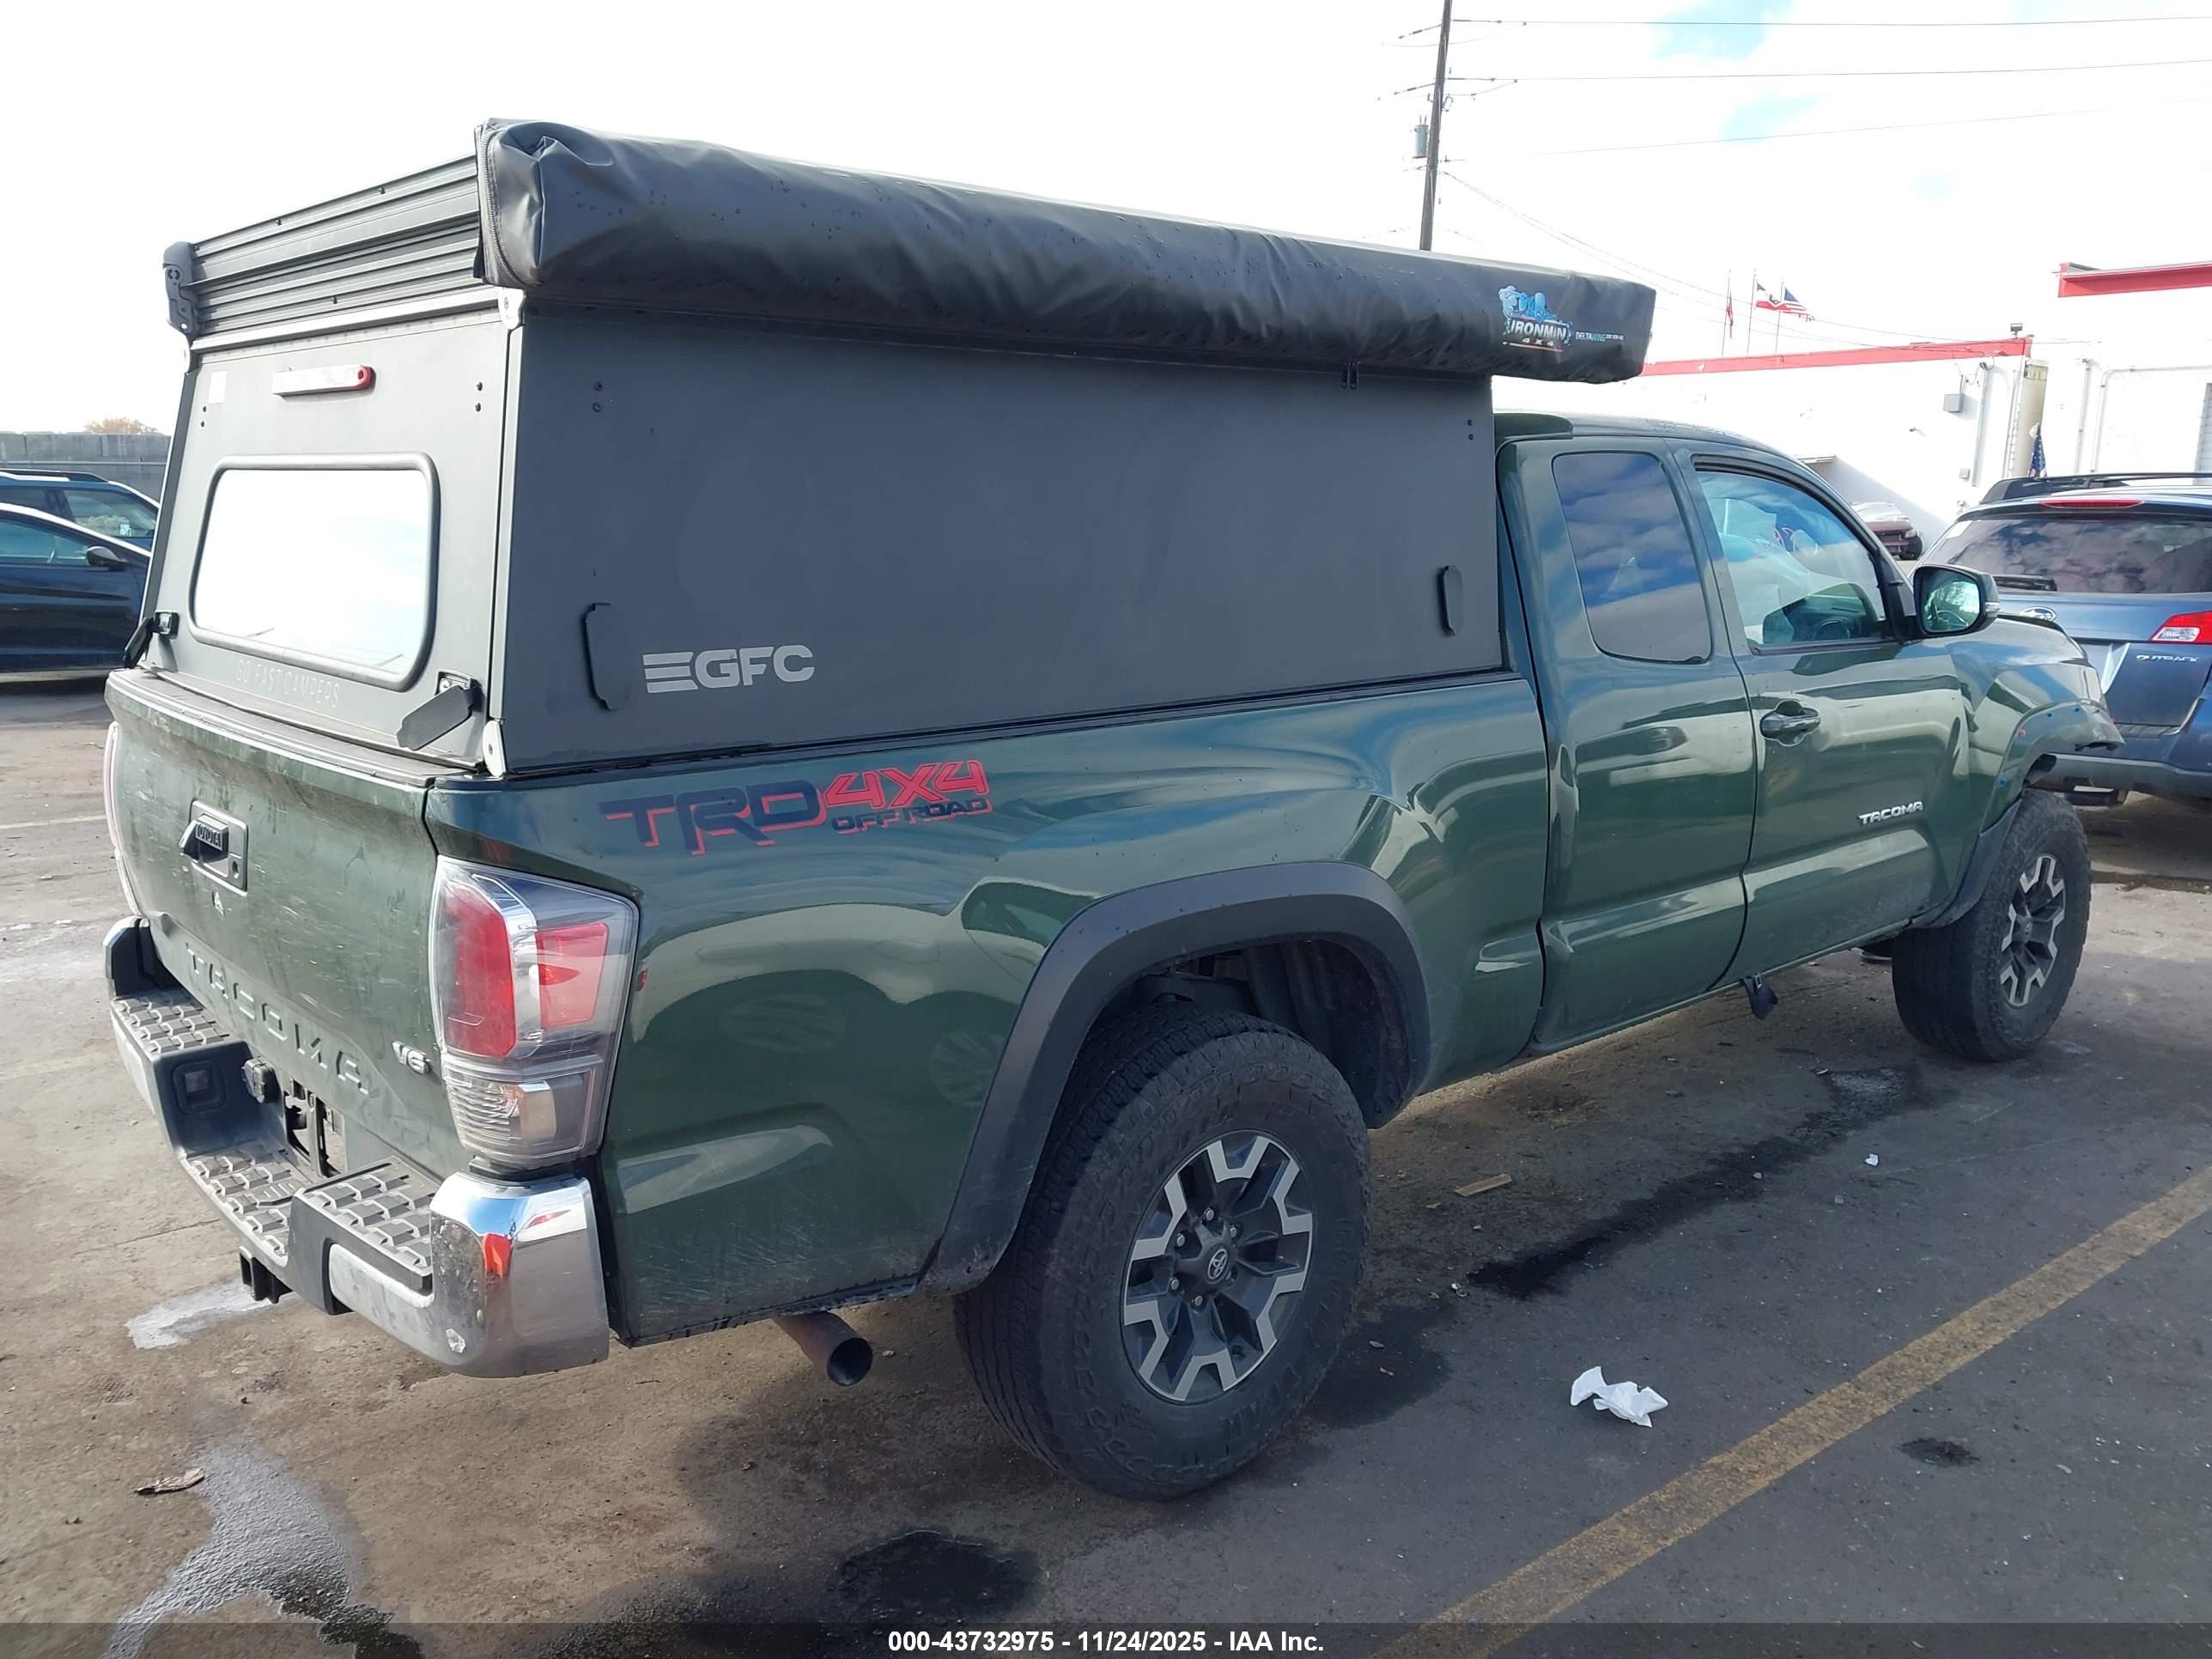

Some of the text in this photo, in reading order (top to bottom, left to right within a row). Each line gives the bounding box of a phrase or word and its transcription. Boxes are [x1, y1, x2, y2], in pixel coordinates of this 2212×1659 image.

[2136, 654, 2200, 663] OUTBACK
[235, 659, 340, 708] GO FAST CAMPERS
[598, 779, 827, 856] TRD
[1857, 800, 1923, 824] TACOMA
[185, 941, 370, 1096] TACOMA
[391, 1040, 428, 1074] V6
